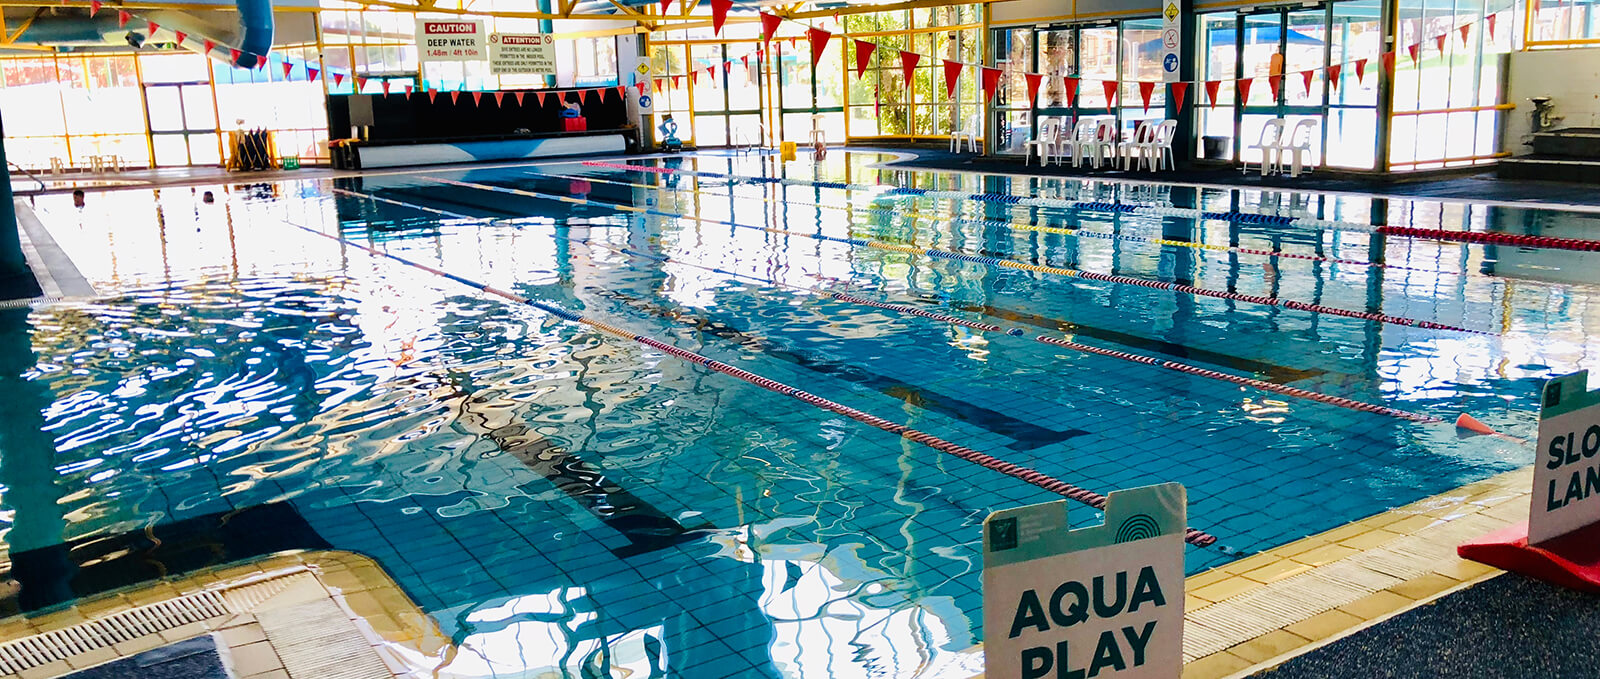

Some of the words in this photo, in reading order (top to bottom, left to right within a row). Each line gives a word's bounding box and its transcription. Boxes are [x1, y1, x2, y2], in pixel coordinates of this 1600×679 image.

[429, 23, 473, 33] CAUTION
[427, 38, 448, 47] DEEP
[449, 38, 476, 46] WATER
[427, 49, 448, 57] 1.48m
[453, 48, 463, 56] 4ft
[464, 48, 479, 56] 10in
[1008, 565, 1166, 639] AQUA
[1021, 620, 1158, 679] PLAY
